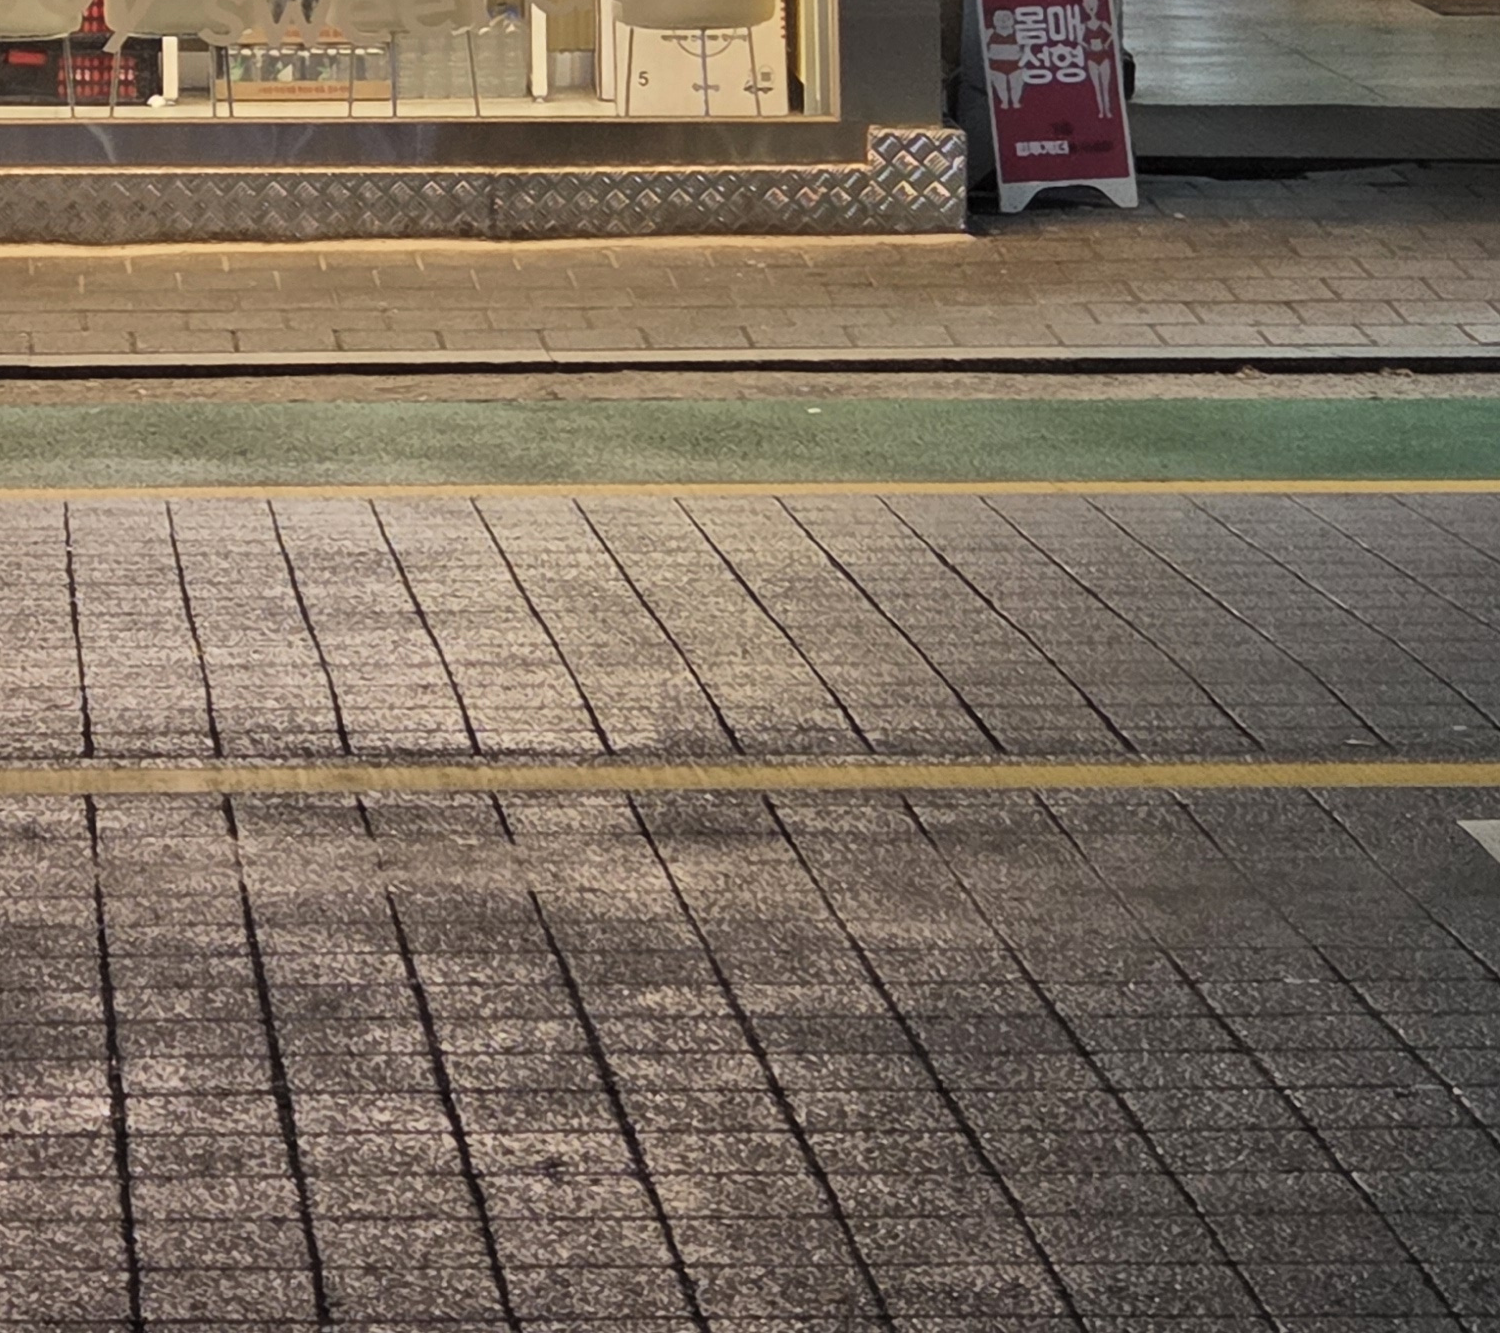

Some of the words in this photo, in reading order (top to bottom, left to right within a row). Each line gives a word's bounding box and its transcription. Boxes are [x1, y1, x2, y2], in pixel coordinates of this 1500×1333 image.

[1014, 4, 1082, 45] 몸매
[638, 71, 650, 86] 5
[1018, 43, 1087, 85] 성형
